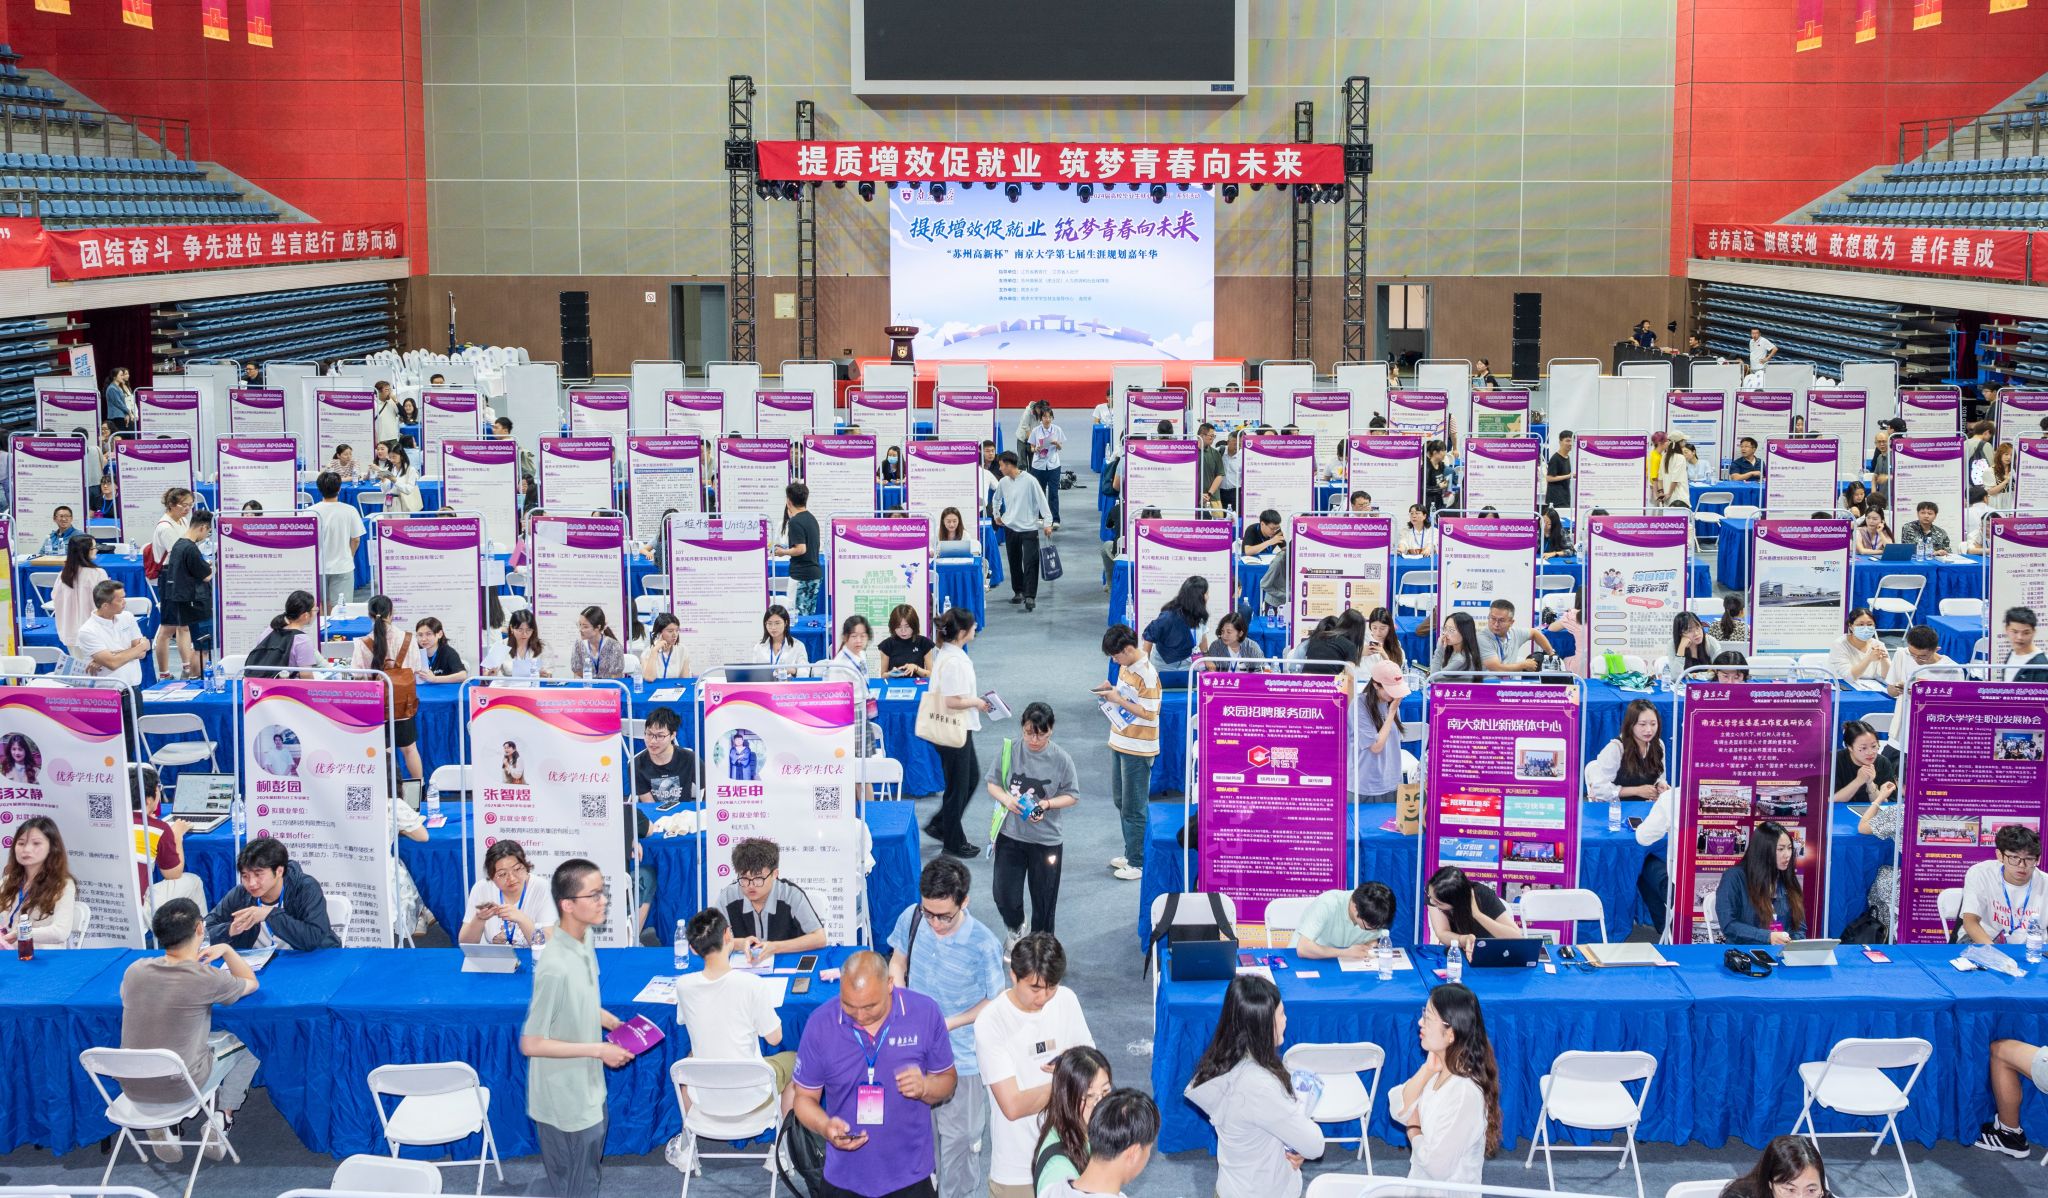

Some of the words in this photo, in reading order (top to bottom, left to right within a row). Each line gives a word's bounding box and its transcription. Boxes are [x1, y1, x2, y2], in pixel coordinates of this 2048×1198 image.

[798, 146, 1040, 177] 提质增效促就业
[1059, 146, 1303, 178] 筑梦青春向未来
[909, 217, 1046, 242] 提质增效促就业
[1053, 209, 1200, 242] 筑梦青春向未来
[79, 236, 173, 269] 团结奋斗
[183, 234, 262, 262] 争先进位
[271, 231, 335, 255] 坐言起行
[342, 229, 397, 253] 应势而动
[1708, 229, 1756, 252] 志存高远
[1764, 231, 1818, 256] 脚踏实地
[1829, 234, 1895, 261] 敢想敢为
[1910, 236, 1995, 268] 善作善成
[1222, 705, 1325, 719] 校园招聘服务团队
[1447, 718, 1562, 732] 南大就业新媒体中心
[1926, 713, 2042, 725] 南京大学学生职业发展协会
[315, 762, 376, 774] 优秀学生代表
[781, 764, 845, 775] 优秀学生代表
[56, 770, 114, 784] 优秀学生代表
[549, 770, 610, 783] 优秀学生代表
[256, 780, 301, 793] 柳彭园
[651, 787, 682, 798] COURAGE
[484, 789, 531, 801] 张智煜
